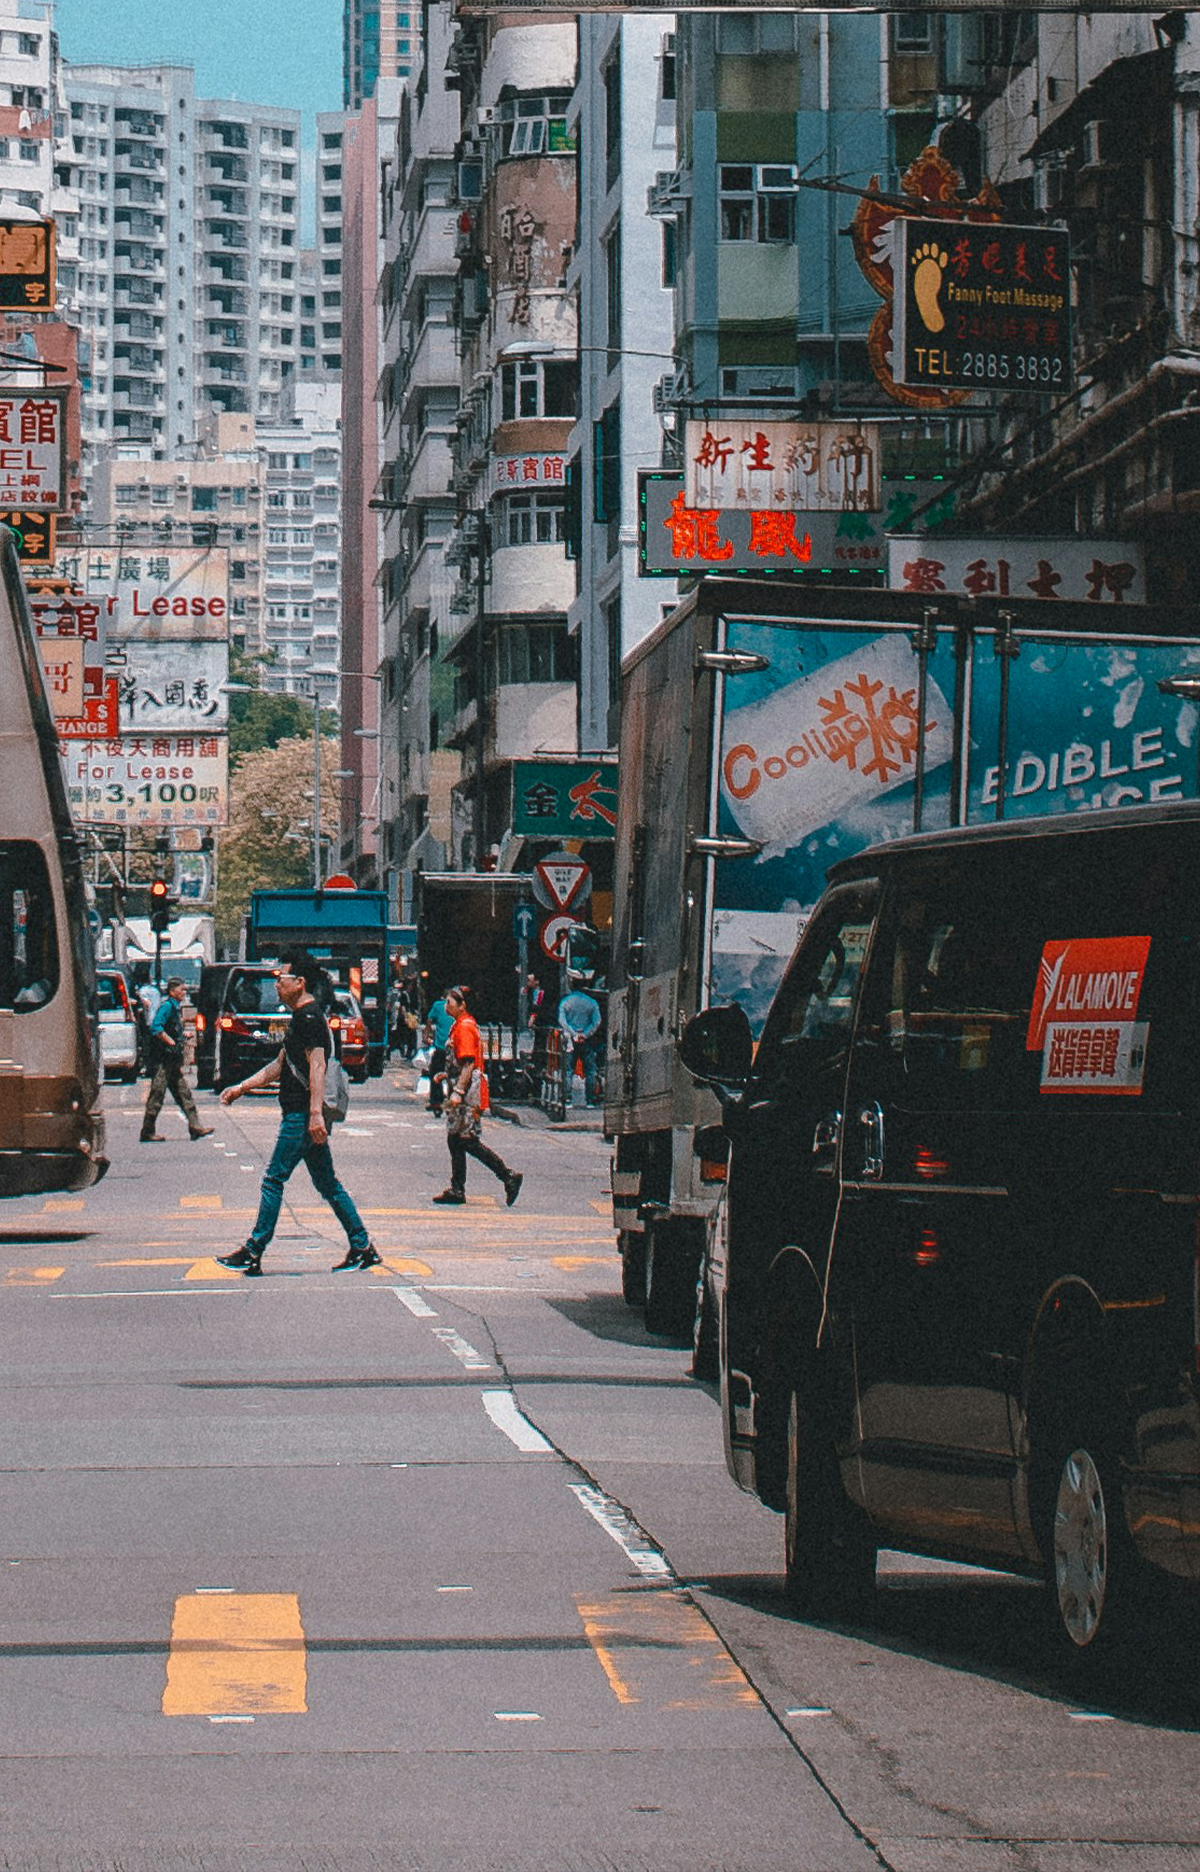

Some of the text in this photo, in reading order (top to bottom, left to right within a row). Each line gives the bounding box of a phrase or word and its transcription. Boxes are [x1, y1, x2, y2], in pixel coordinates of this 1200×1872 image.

[948, 282, 1064, 312] Fanny Foot Massage
[1015, 356, 1063, 382] 3832
[132, 589, 226, 617] Lease
[76, 762, 195, 779] For Lease
[724, 713, 868, 801] Cooling
[981, 727, 1166, 805] EDIBLE
[1055, 971, 1139, 1011] LALAMOVE
